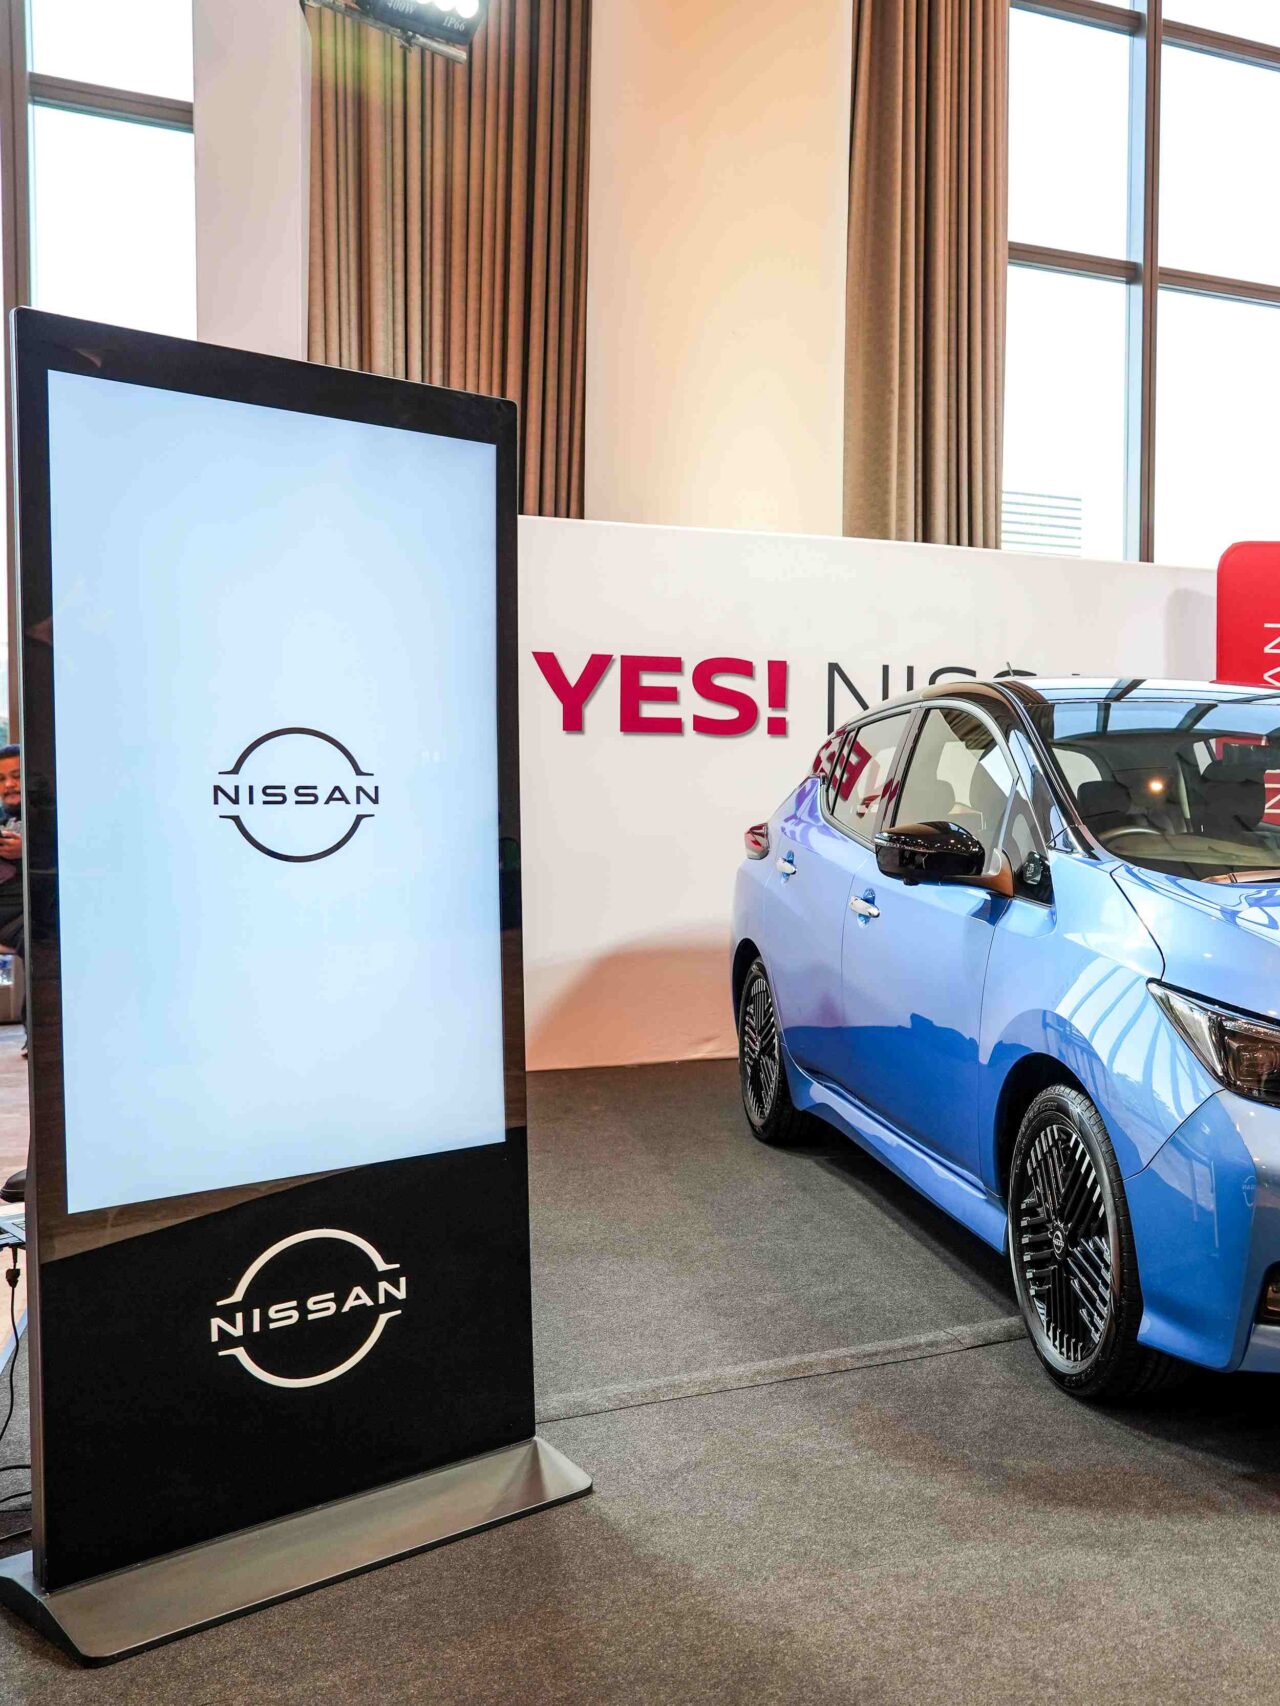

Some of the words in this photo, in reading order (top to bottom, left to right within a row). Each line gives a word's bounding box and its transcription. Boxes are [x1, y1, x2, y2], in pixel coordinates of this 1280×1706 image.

[442, 15, 466, 32] IP66
[531, 651, 788, 737] YES!
[213, 784, 380, 806] NISSAN
[210, 1276, 407, 1343] NISSAN
